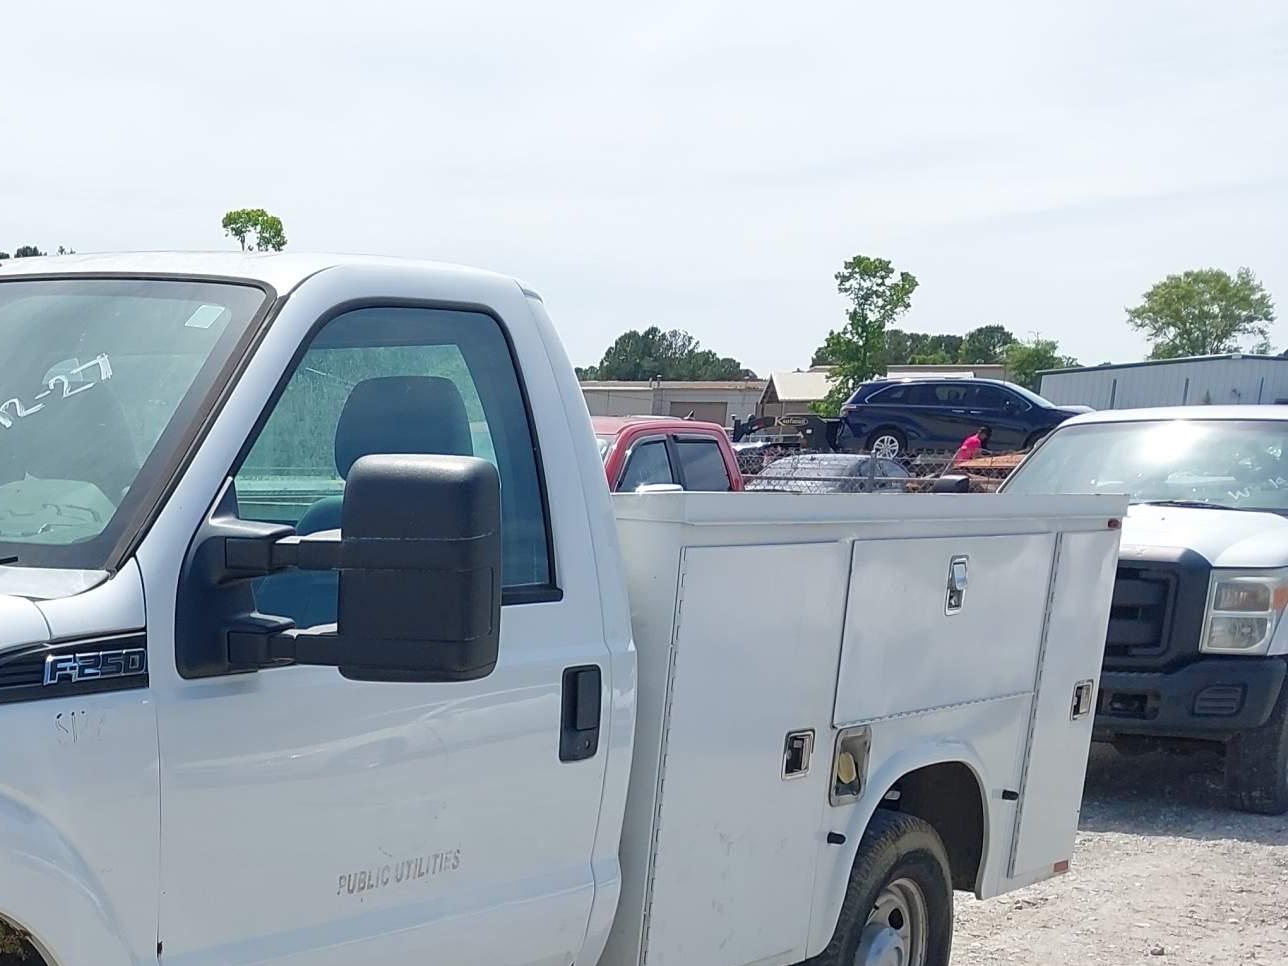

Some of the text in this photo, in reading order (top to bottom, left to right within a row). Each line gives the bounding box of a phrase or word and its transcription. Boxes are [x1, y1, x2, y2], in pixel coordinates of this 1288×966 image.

[44, 649, 147, 685] F-250
[337, 849, 461, 895] PUBLIC UTILITIES
